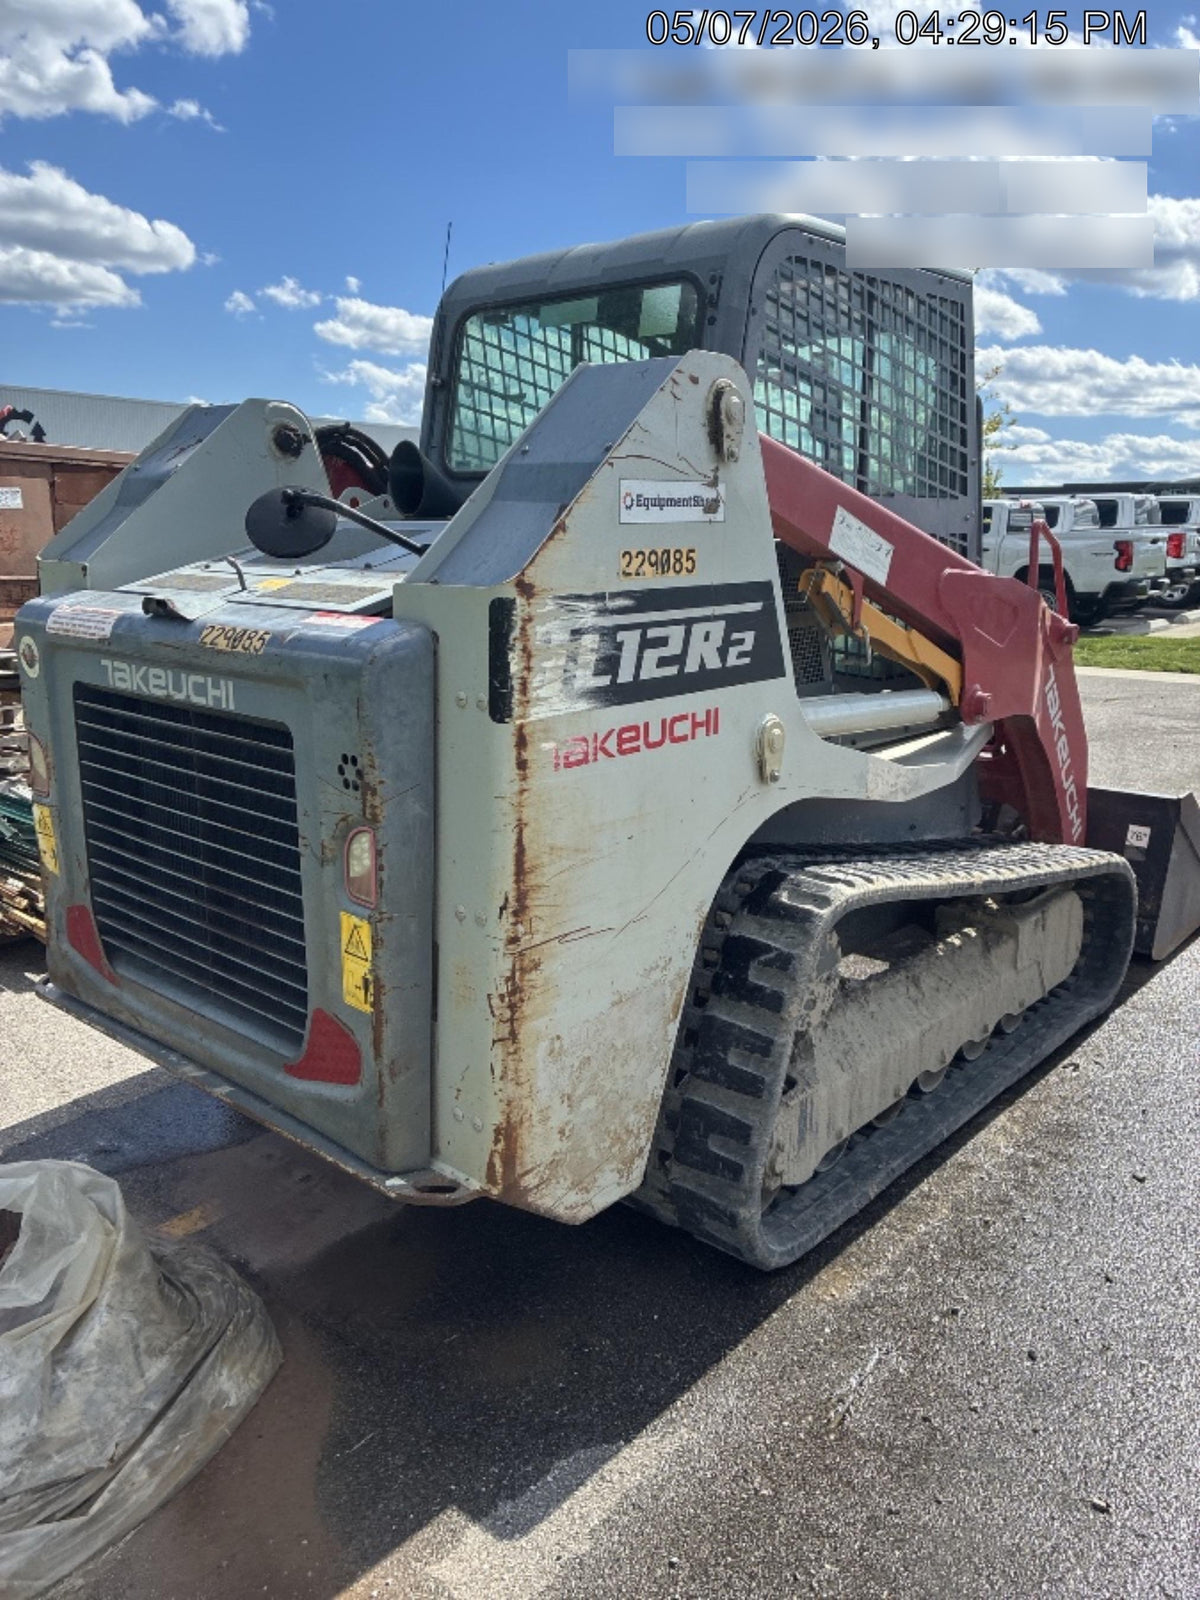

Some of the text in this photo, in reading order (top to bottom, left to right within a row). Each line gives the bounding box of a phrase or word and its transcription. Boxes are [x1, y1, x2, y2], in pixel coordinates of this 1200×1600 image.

[621, 548, 696, 577] 229085
[201, 625, 269, 652] 229085
[546, 618, 756, 693] L12R2
